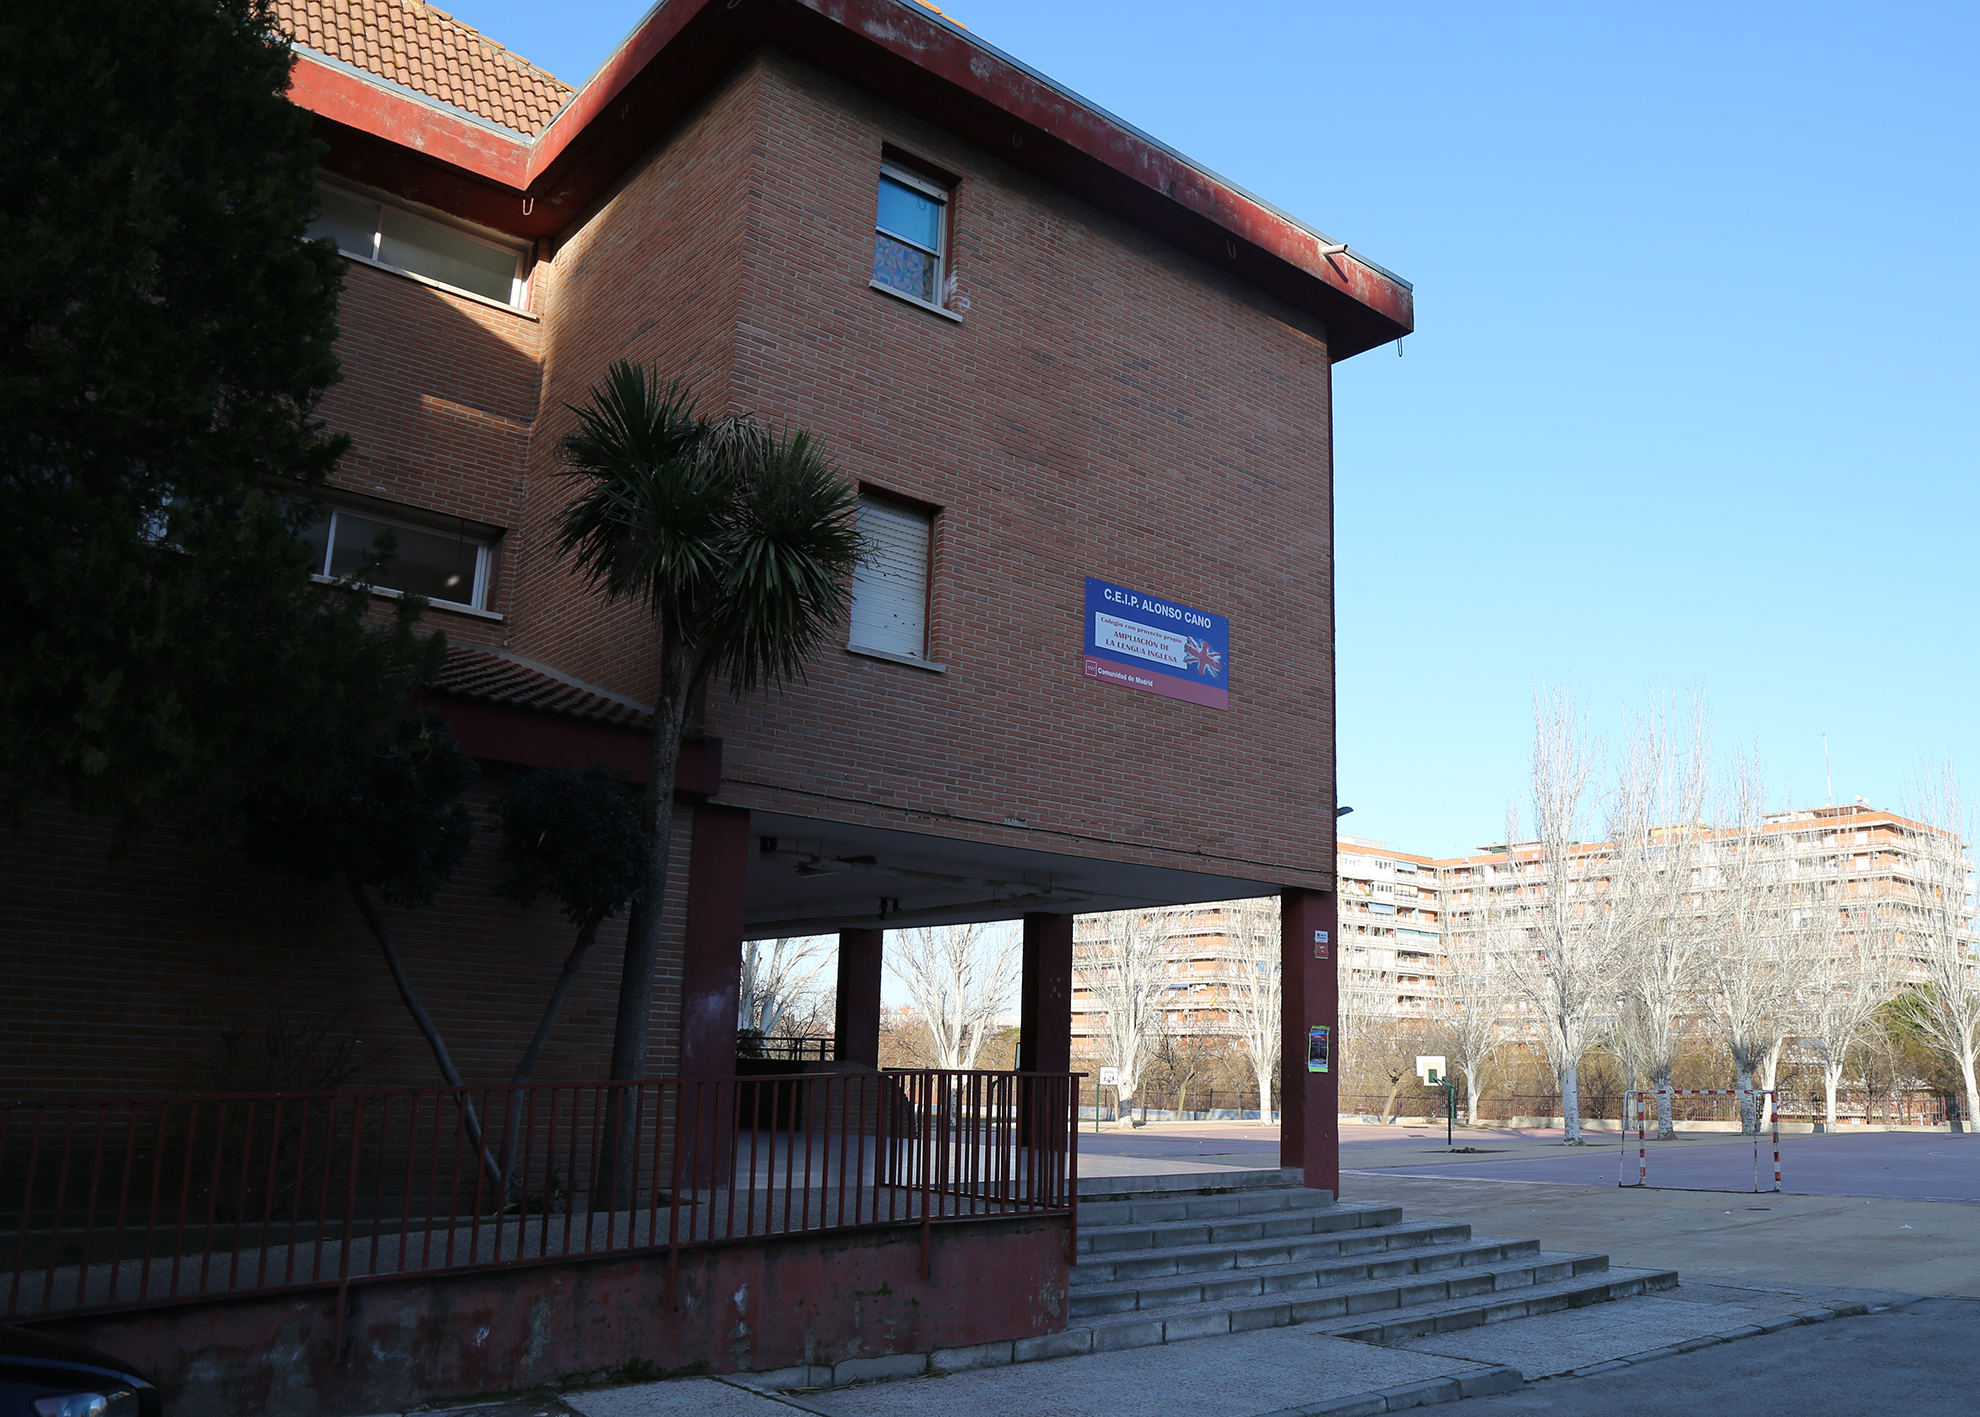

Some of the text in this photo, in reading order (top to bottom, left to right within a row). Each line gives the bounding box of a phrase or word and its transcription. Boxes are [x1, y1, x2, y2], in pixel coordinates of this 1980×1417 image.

[1104, 588, 1211, 629] C.E.I.P. ALONSO CANO
[1101, 616, 1123, 628] Colegio
[1137, 627, 1162, 638] proyecto
[1163, 634, 1182, 644] propio
[1113, 631, 1170, 651] AMPLIACIÓN DE
[1117, 641, 1146, 655] LENGUA
[1147, 650, 1177, 663] INGLESA
[1098, 667, 1153, 687] Comunidad de Madrid
